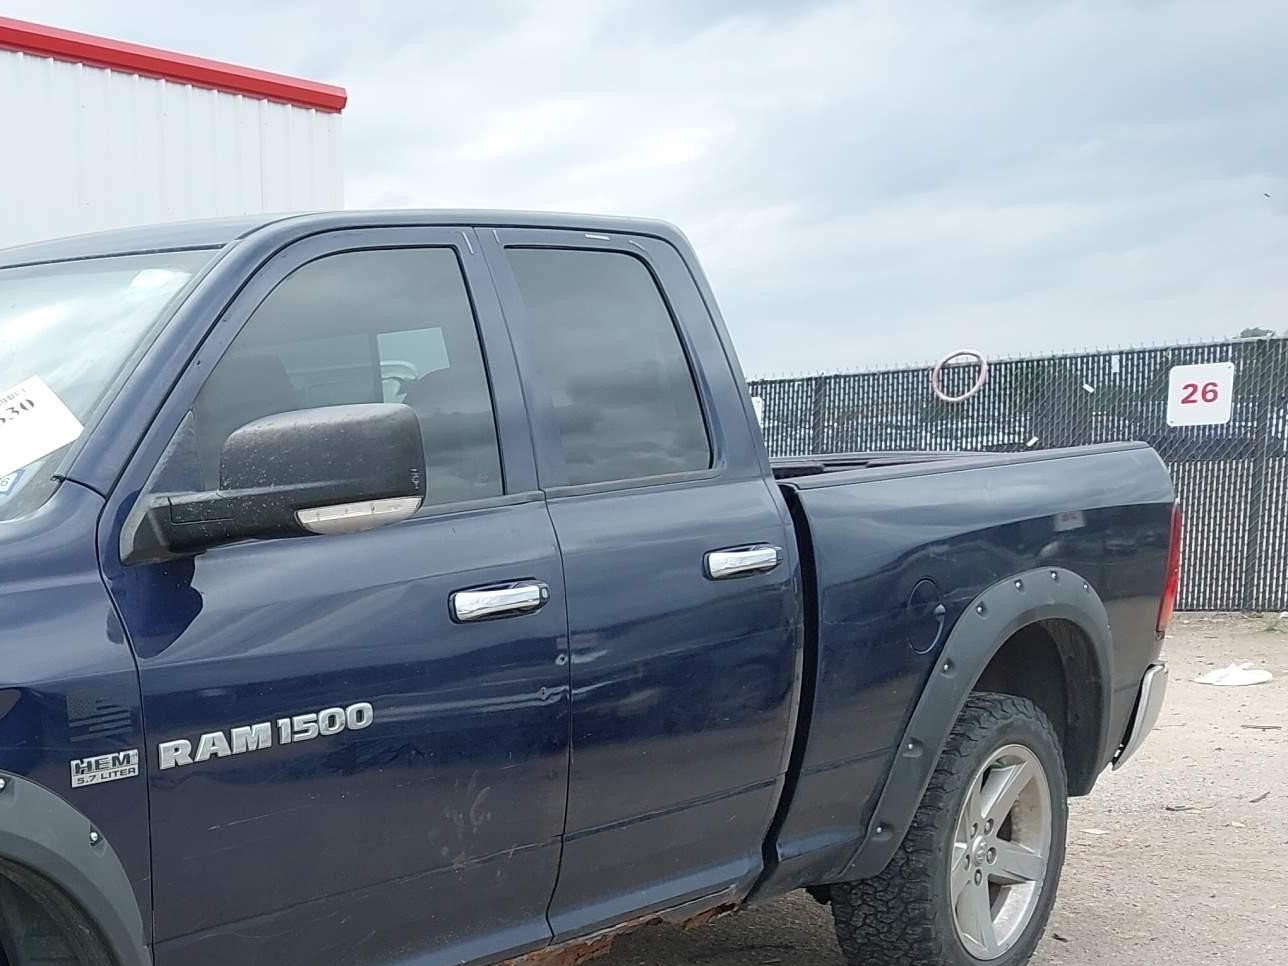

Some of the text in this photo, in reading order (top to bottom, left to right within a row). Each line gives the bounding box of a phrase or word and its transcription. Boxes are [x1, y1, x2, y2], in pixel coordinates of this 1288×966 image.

[1180, 381, 1219, 405] 26
[158, 702, 374, 770] RAM 1500
[76, 766, 136, 785] 5.7 LITER
